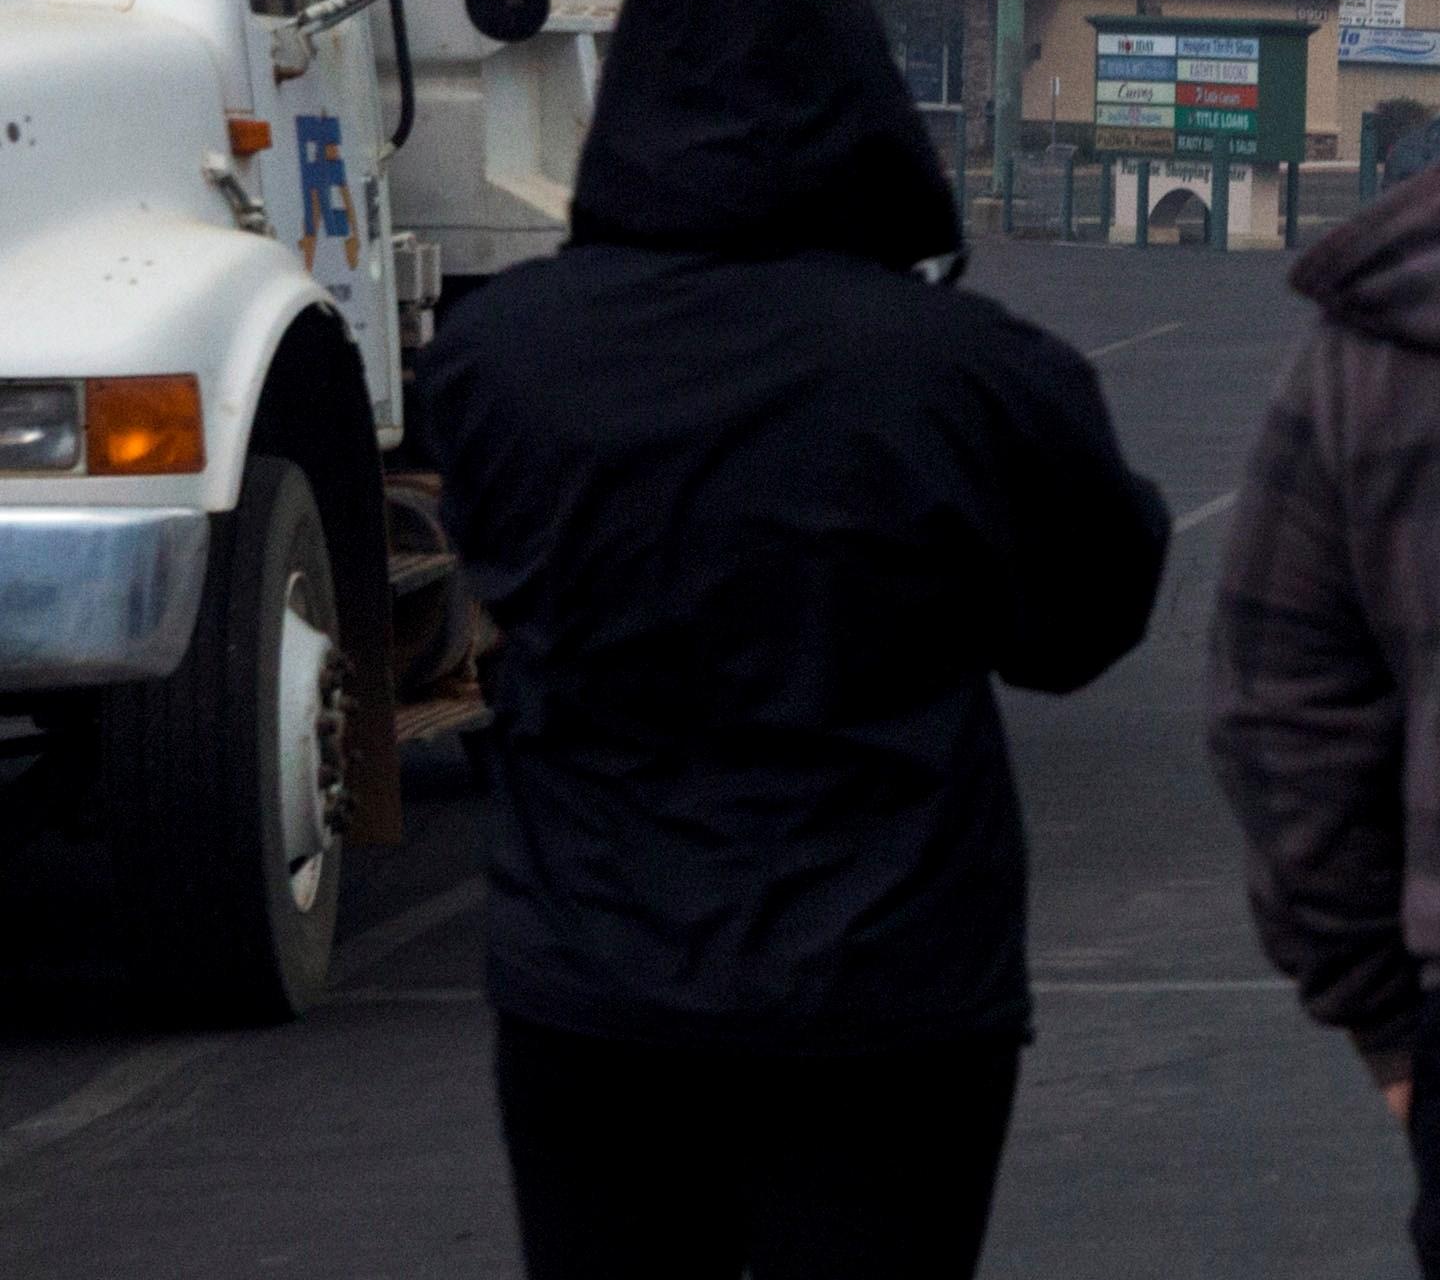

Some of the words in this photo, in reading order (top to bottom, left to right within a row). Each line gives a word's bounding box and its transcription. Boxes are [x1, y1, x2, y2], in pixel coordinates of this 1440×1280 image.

[1118, 83, 1153, 102] Curves
[1196, 111, 1219, 128] TITLE
[1221, 113, 1249, 130] LOANS
[1165, 159, 1211, 184] Shopping
